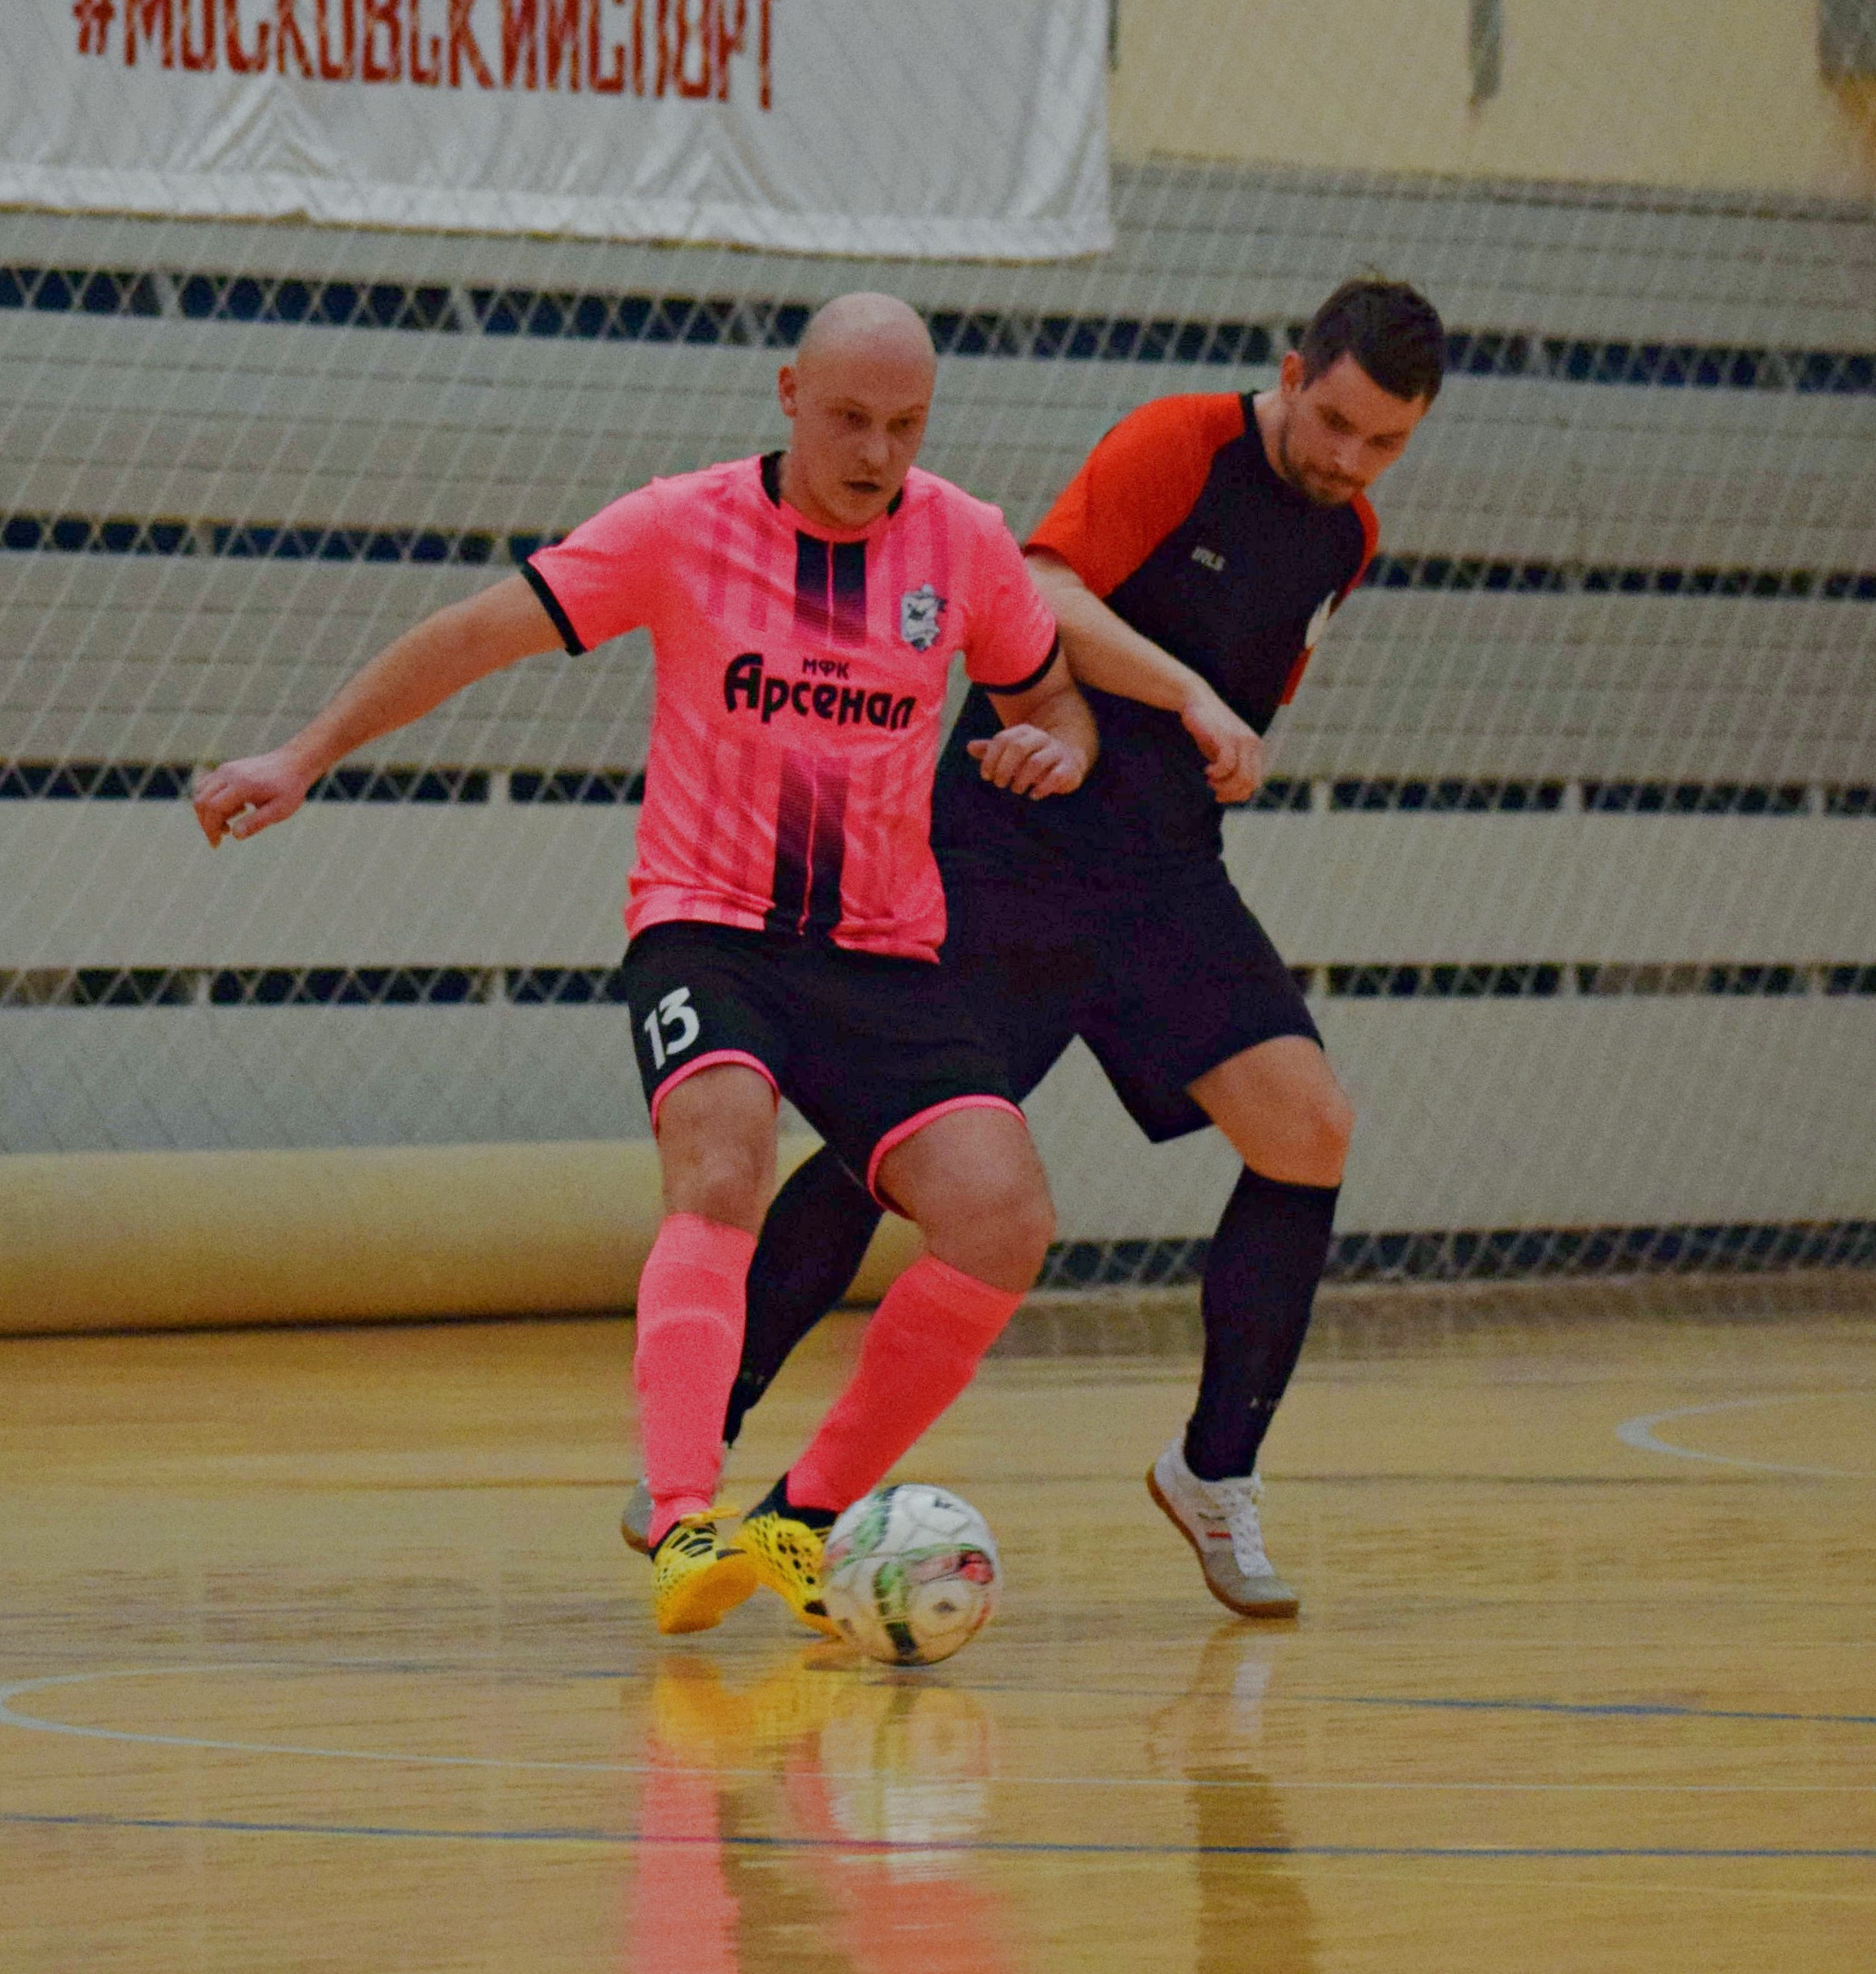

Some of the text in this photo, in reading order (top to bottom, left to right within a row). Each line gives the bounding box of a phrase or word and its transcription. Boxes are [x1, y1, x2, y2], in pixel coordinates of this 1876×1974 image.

[724, 653, 916, 731] Арсенал
[802, 657, 850, 680] МФК
[644, 986, 700, 1071] 13
